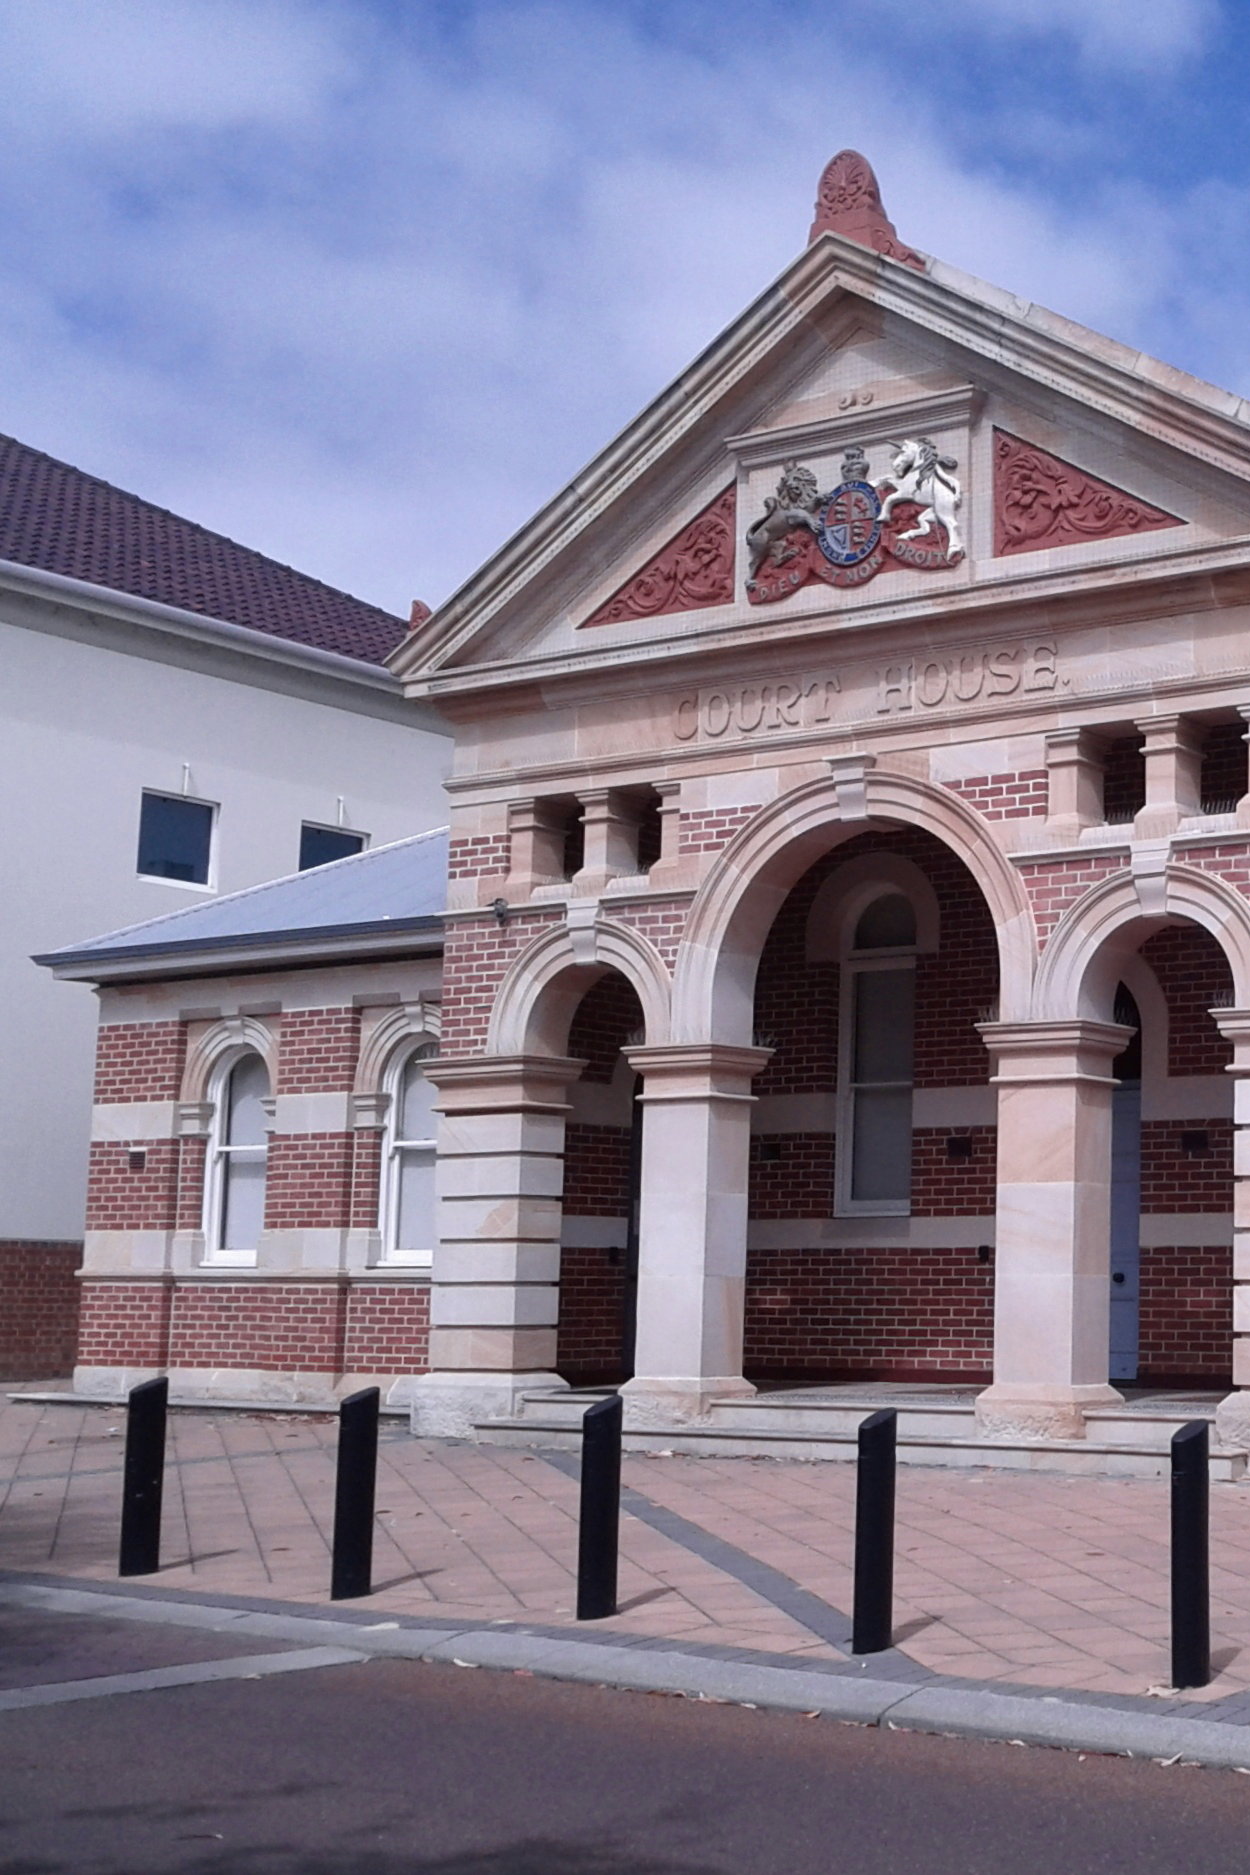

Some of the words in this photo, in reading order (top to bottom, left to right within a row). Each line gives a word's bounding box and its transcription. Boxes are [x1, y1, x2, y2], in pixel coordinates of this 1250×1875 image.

[759, 569, 800, 601] DIEU
[819, 564, 841, 582] ET
[894, 542, 946, 567] DROIT
[673, 674, 841, 741] COURT
